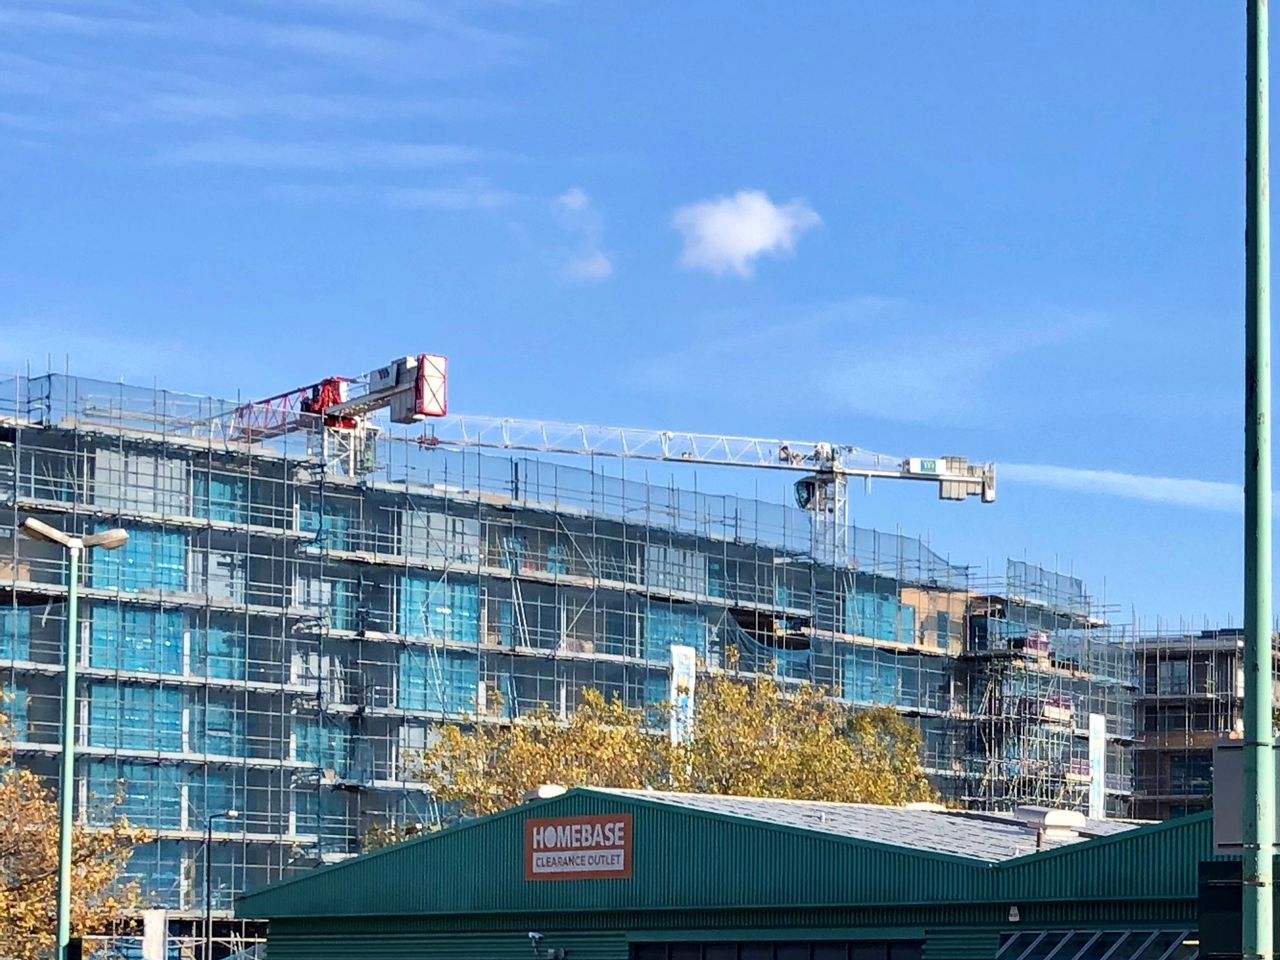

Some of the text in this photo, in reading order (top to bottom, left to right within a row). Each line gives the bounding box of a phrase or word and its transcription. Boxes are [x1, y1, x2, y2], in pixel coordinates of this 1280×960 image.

[533, 822, 625, 849] HOMEBASE
[535, 854, 621, 868] CLEARANCE OUTLET
